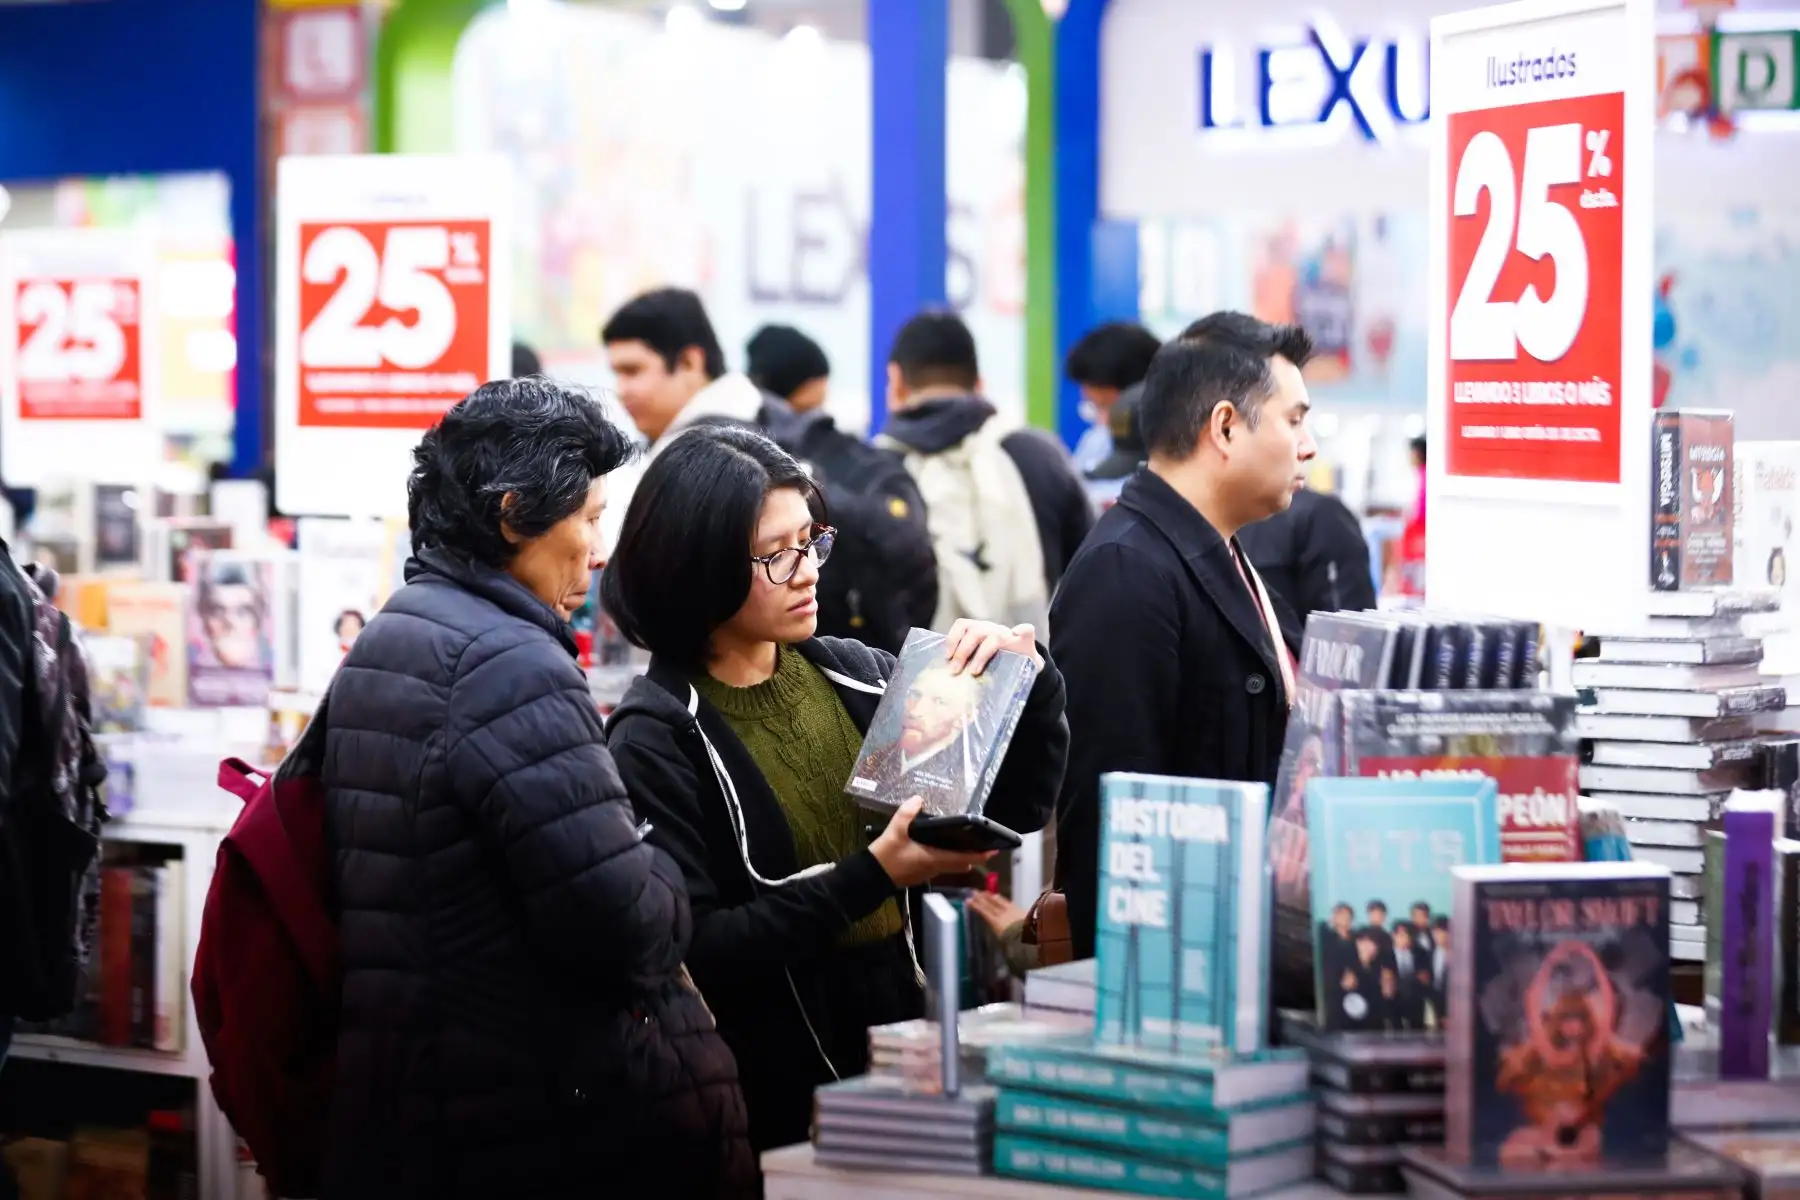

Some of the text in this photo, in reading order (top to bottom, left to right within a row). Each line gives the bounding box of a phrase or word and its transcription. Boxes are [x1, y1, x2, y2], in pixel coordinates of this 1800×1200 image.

[1487, 48, 1577, 89] Ilustrados
[1450, 122, 1588, 362] 25
[1585, 129, 1613, 178] %
[301, 226, 458, 369] 25
[19, 279, 127, 384] 25
[1110, 796, 1229, 844] HISTORIA
[1110, 841, 1160, 884] DEL
[1107, 885, 1168, 928] CINE
